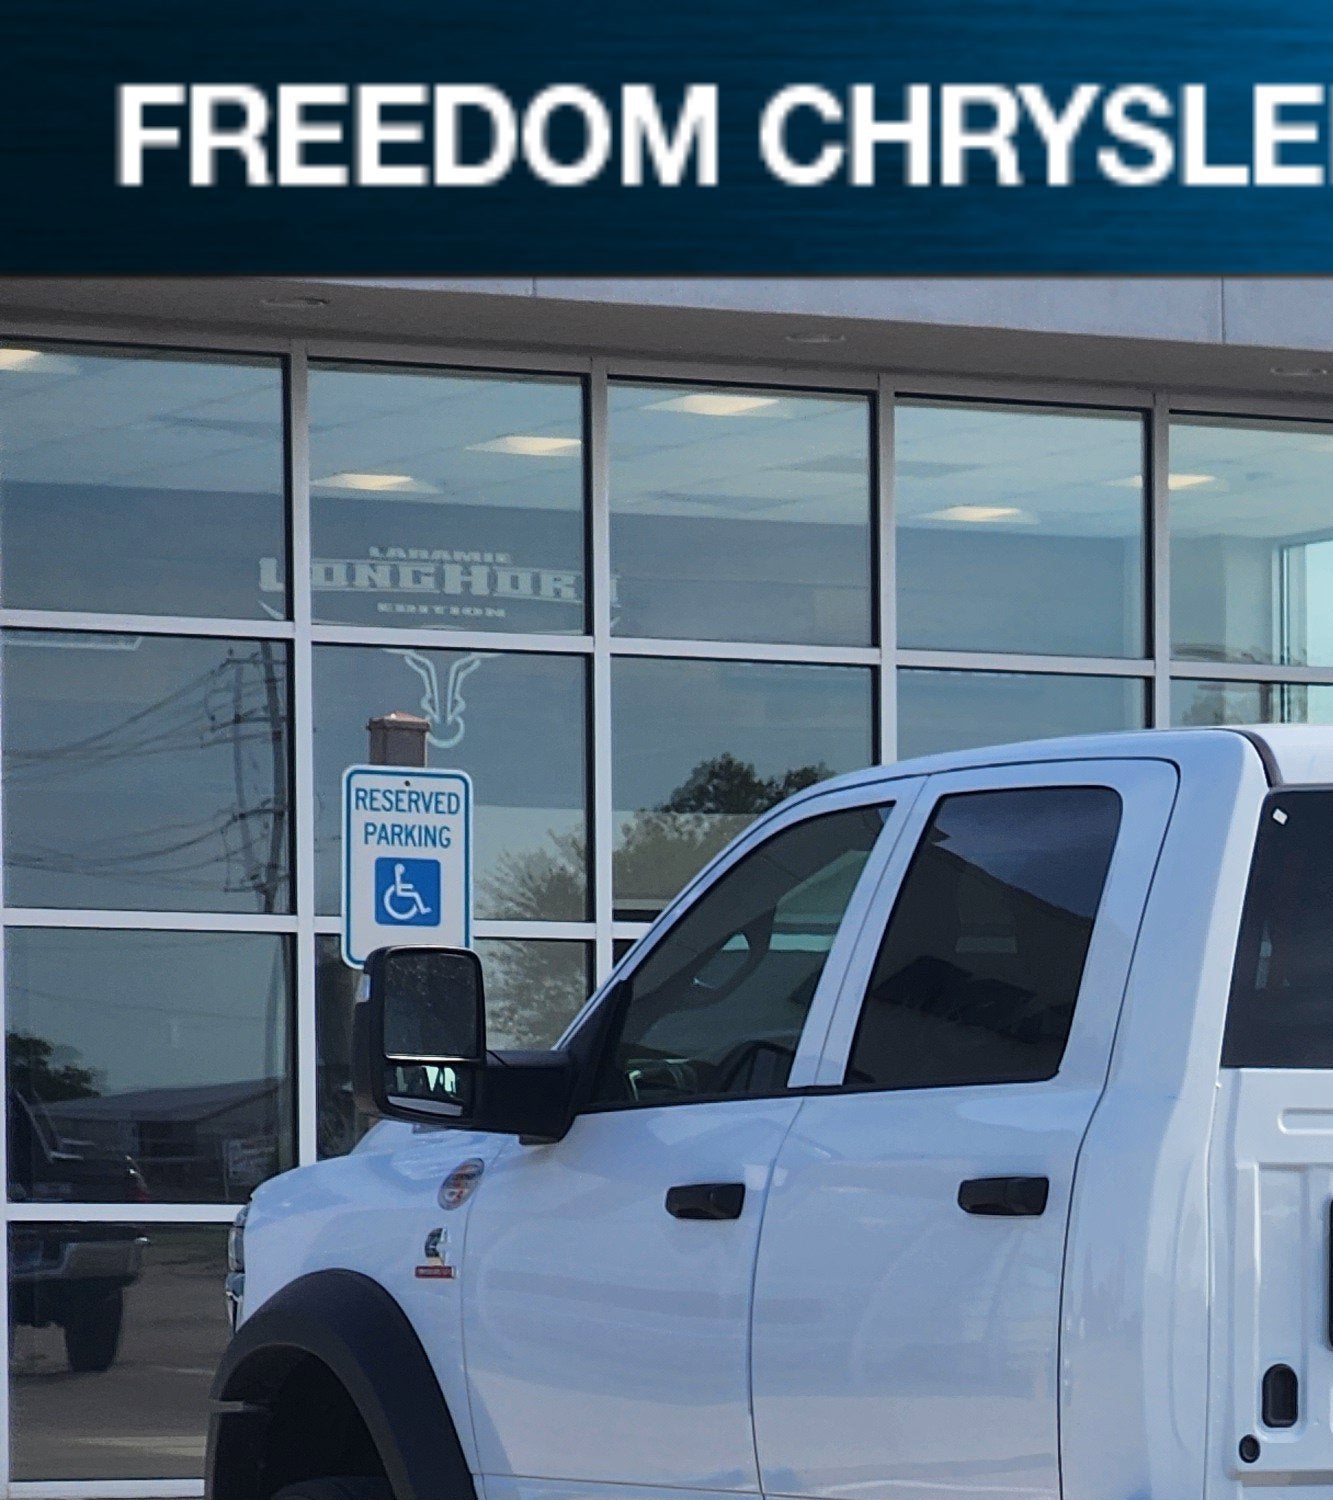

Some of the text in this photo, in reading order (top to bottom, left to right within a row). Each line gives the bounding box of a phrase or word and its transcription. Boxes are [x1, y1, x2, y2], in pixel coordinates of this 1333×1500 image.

[258, 556, 621, 607] LONGHOR
[376, 601, 507, 619] EDITION
[354, 786, 461, 816] RESERVED
[363, 822, 452, 849] PARKING
